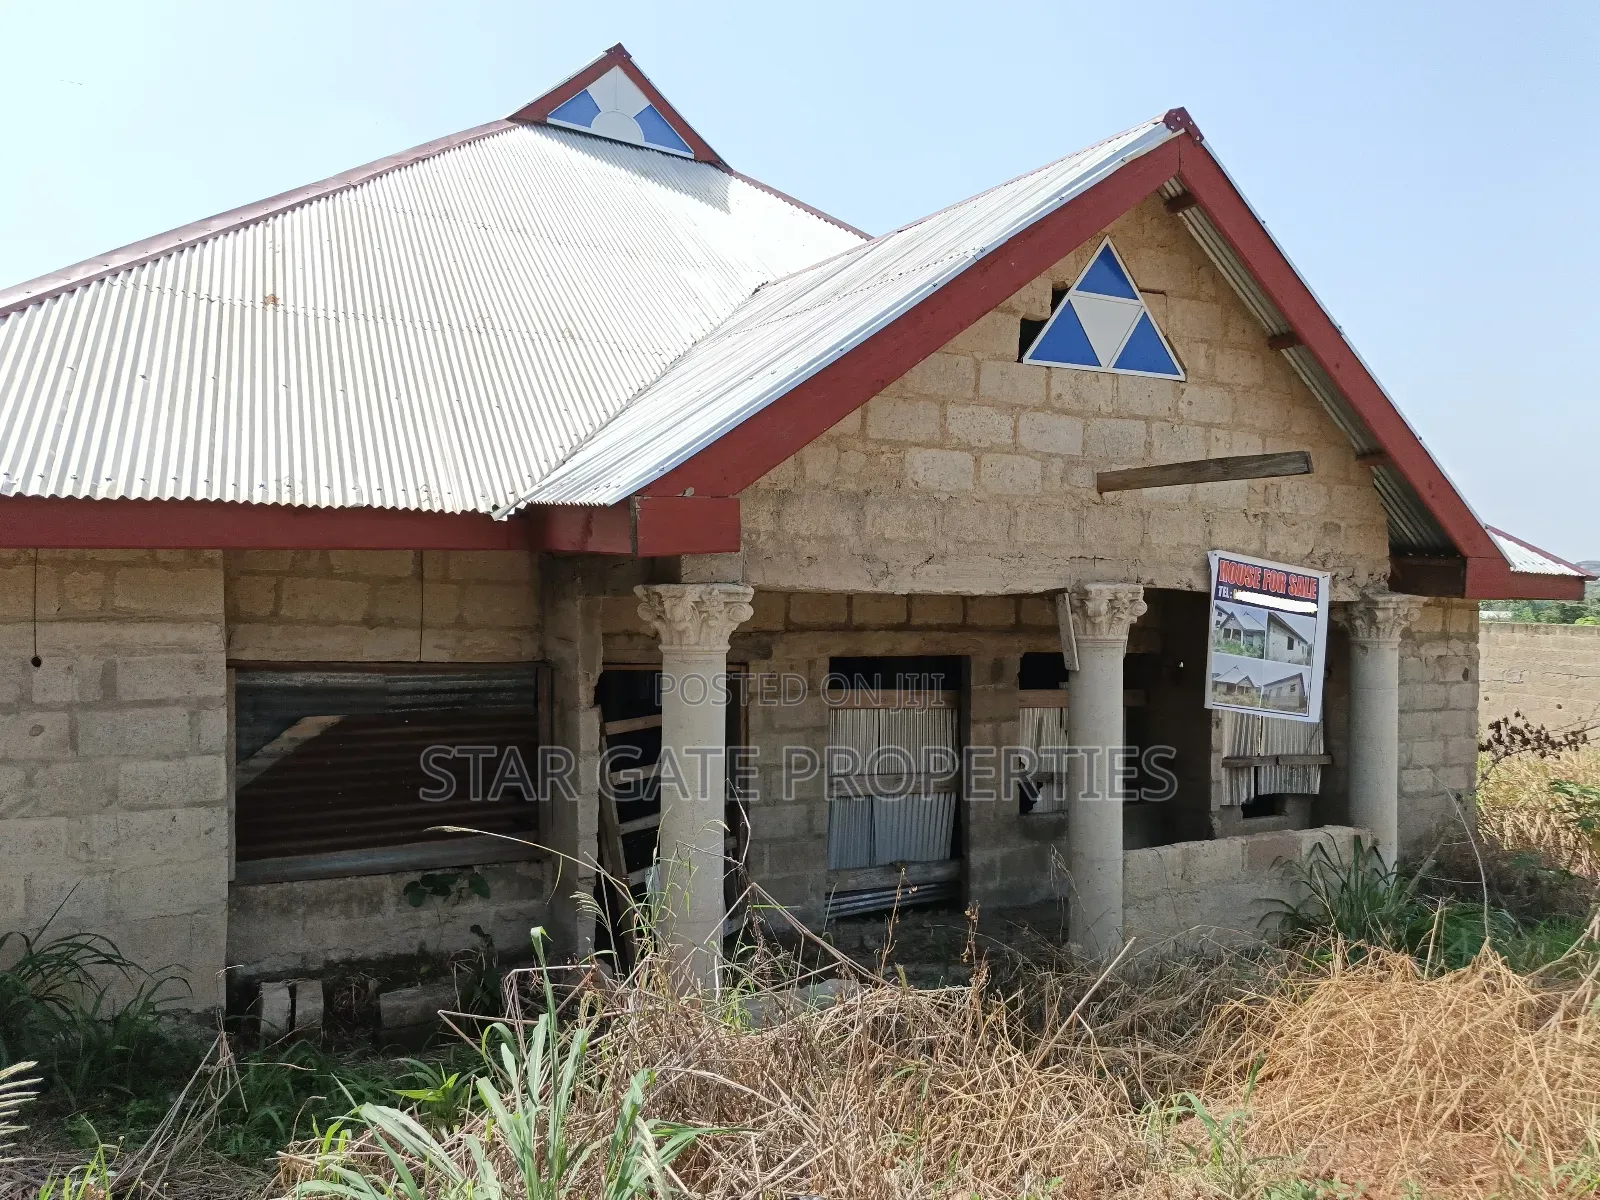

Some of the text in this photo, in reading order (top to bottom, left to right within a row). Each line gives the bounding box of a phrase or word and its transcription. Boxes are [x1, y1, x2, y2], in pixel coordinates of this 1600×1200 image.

[1218, 559, 1317, 599] HOUSE FOR SALE
